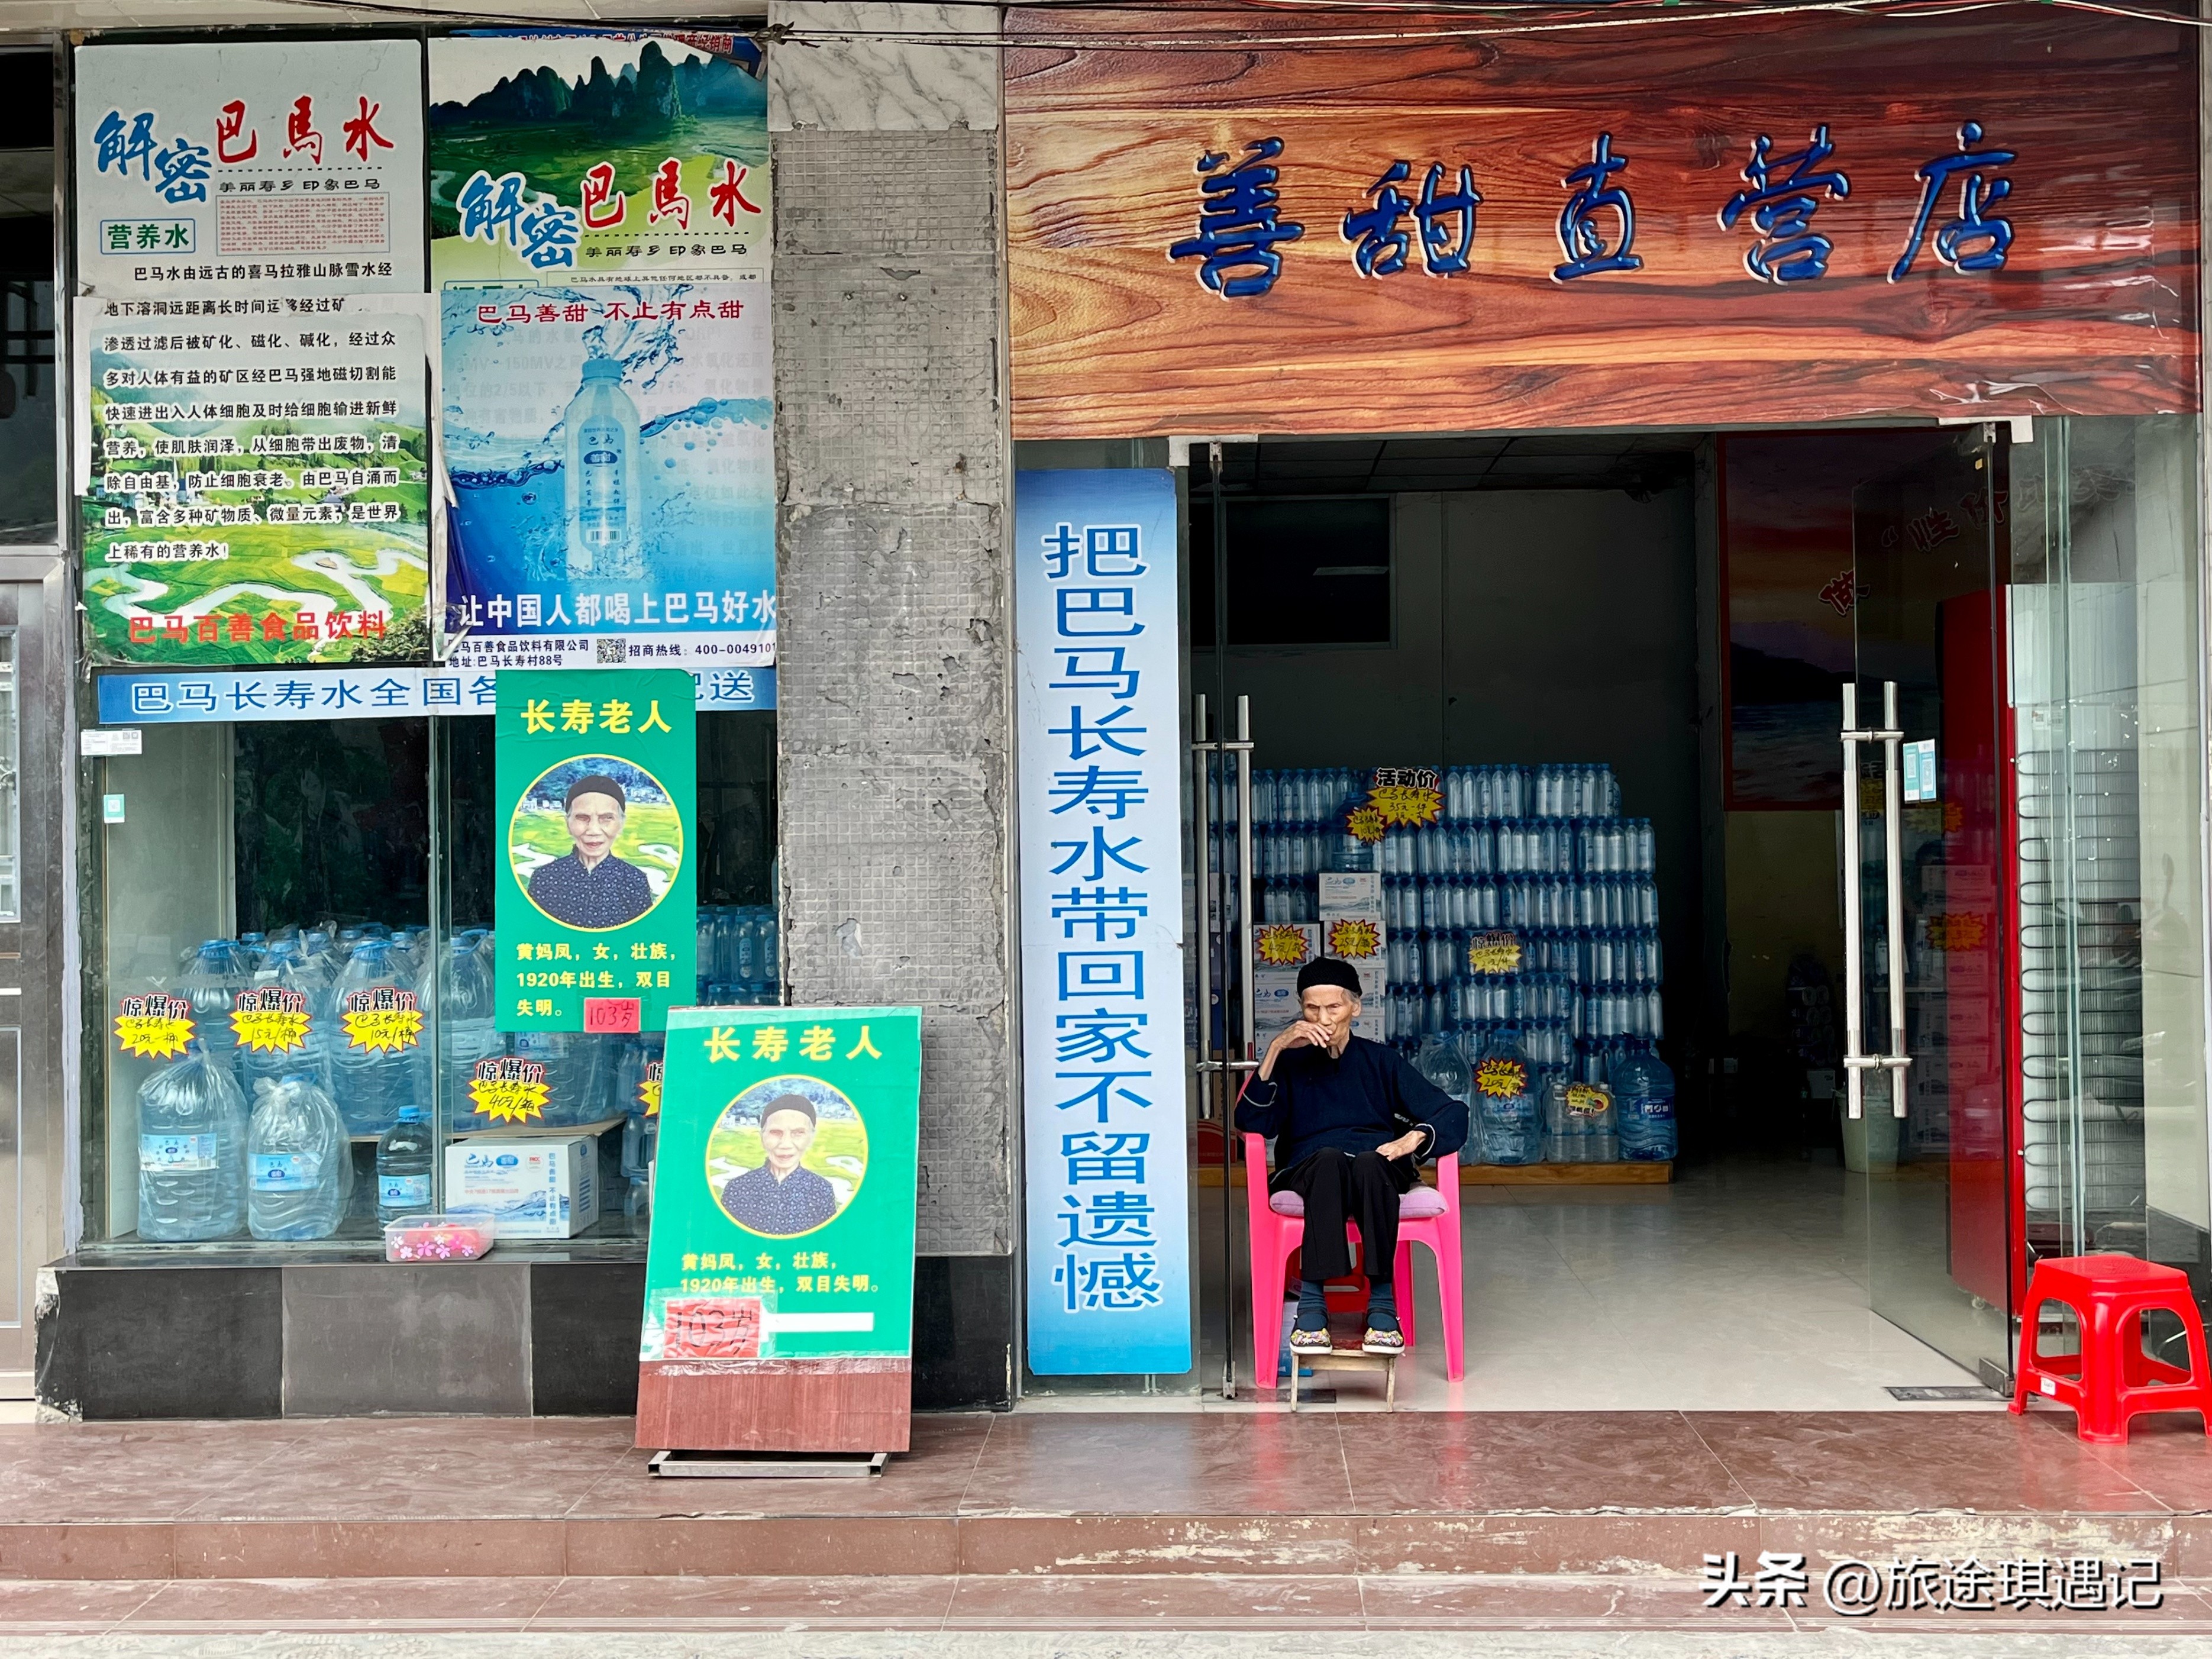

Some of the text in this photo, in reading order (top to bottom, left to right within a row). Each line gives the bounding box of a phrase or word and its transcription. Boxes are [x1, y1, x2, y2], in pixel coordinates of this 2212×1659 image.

[1167, 121, 2017, 299] 善甜直营店
[107, 224, 190, 250] 营养水
[134, 262, 393, 280] 巴马水由远古的喜马拉雅山脉雪水经
[477, 300, 744, 323] 巴马善甜 不止有点甜
[104, 331, 396, 351] 渗透过滤后被矿化、磁化、碱化，经过众
[105, 366, 396, 386] 多对人体有益的矿区经巴马强地磁切割能
[105, 401, 396, 421] 快速进出入人体细胞及时给细胞输进新鲜
[105, 435, 398, 456] 营养，使肌肤润泽，从细胞带出废物，清
[459, 590, 776, 628] 让中国人都喝上巴马好水
[128, 611, 387, 643] 巴马百善食品饮料
[521, 699, 671, 734] 长寿老人
[1378, 769, 1436, 788] 活动价
[1044, 525, 1162, 1311] 把巴马长寿水带回家不留遗憾
[516, 944, 676, 961] 黄妈凤，女，壮族，
[517, 971, 670, 988] 1920年出生，双目
[123, 995, 186, 1019] 惊爆价
[238, 989, 301, 1012] 惊爆价
[351, 989, 413, 1012] 惊爆价
[516, 999, 561, 1017] 失明。
[589, 1002, 634, 1028] 103岁
[703, 1025, 882, 1062] 长寿老人
[478, 1059, 541, 1083] 惊爆价
[682, 1252, 837, 1270] 黄妈凤，女，壮族，
[680, 1274, 879, 1294] 1920年出生，双目失明。
